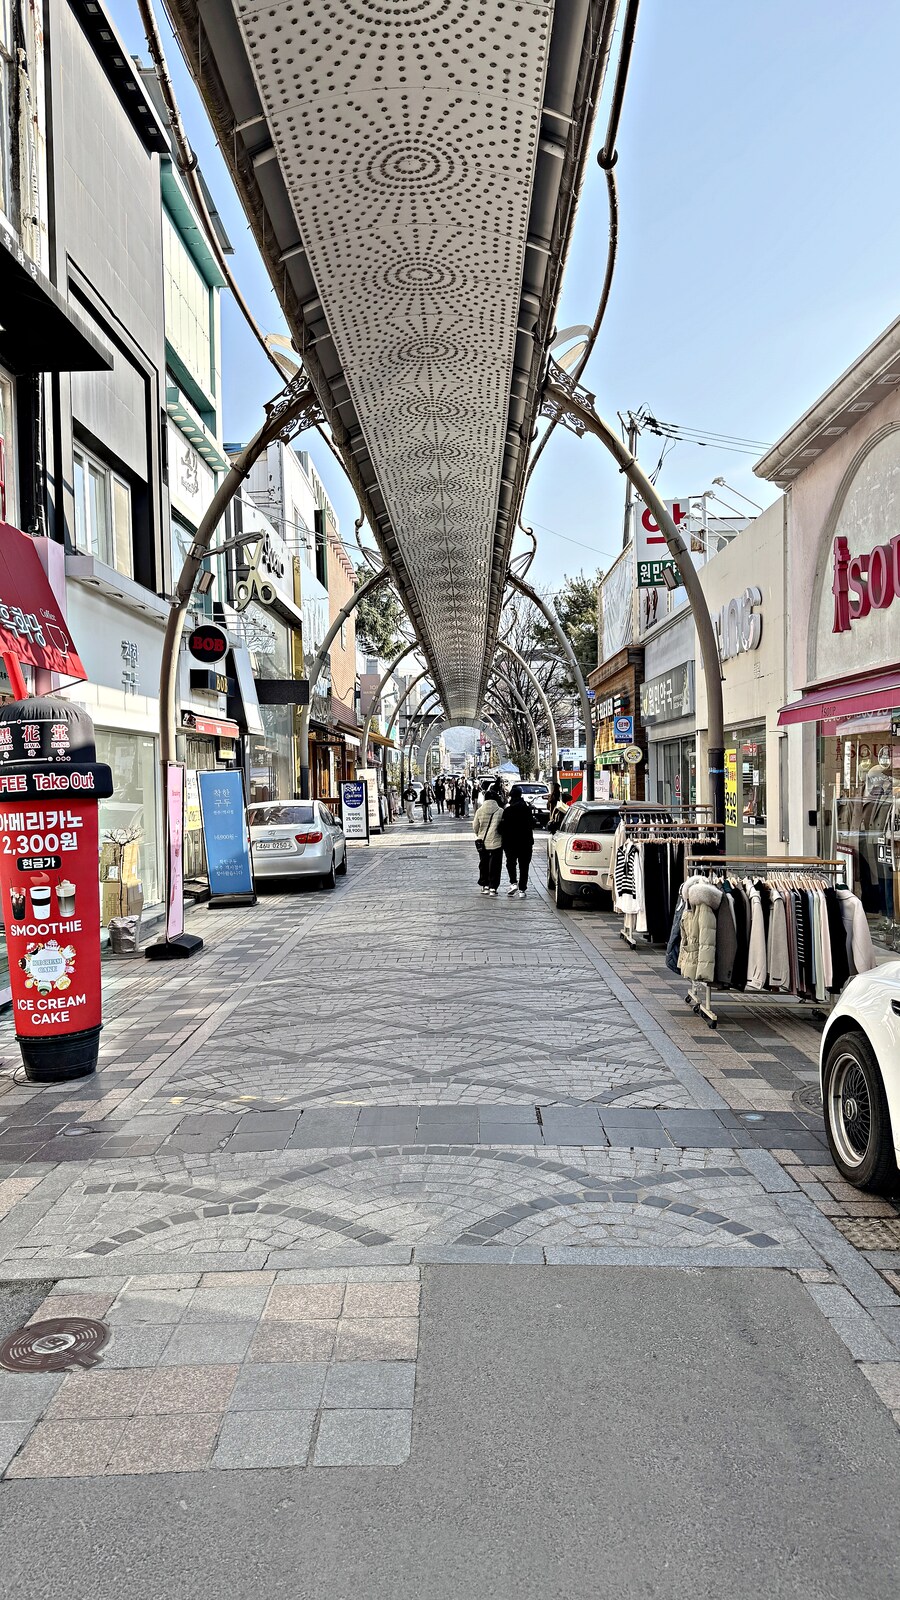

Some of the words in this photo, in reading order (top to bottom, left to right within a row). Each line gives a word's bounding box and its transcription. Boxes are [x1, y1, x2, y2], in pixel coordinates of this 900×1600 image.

[192, 636, 224, 652] BOB
[216, 674, 228, 692] BOB
[648, 678, 673, 716] 원민약국
[33, 773, 69, 791] Take
[70, 772, 95, 790] Out
[0, 810, 84, 832] 아메리카노
[2, 831, 78, 855] 2,300원
[22, 857, 56, 869] 현금가
[10, 920, 82, 936] SMOOTHIE
[17, 999, 35, 1010] ICE
[36, 993, 87, 1010] CREAM
[31, 1010, 70, 1025] CAKE
